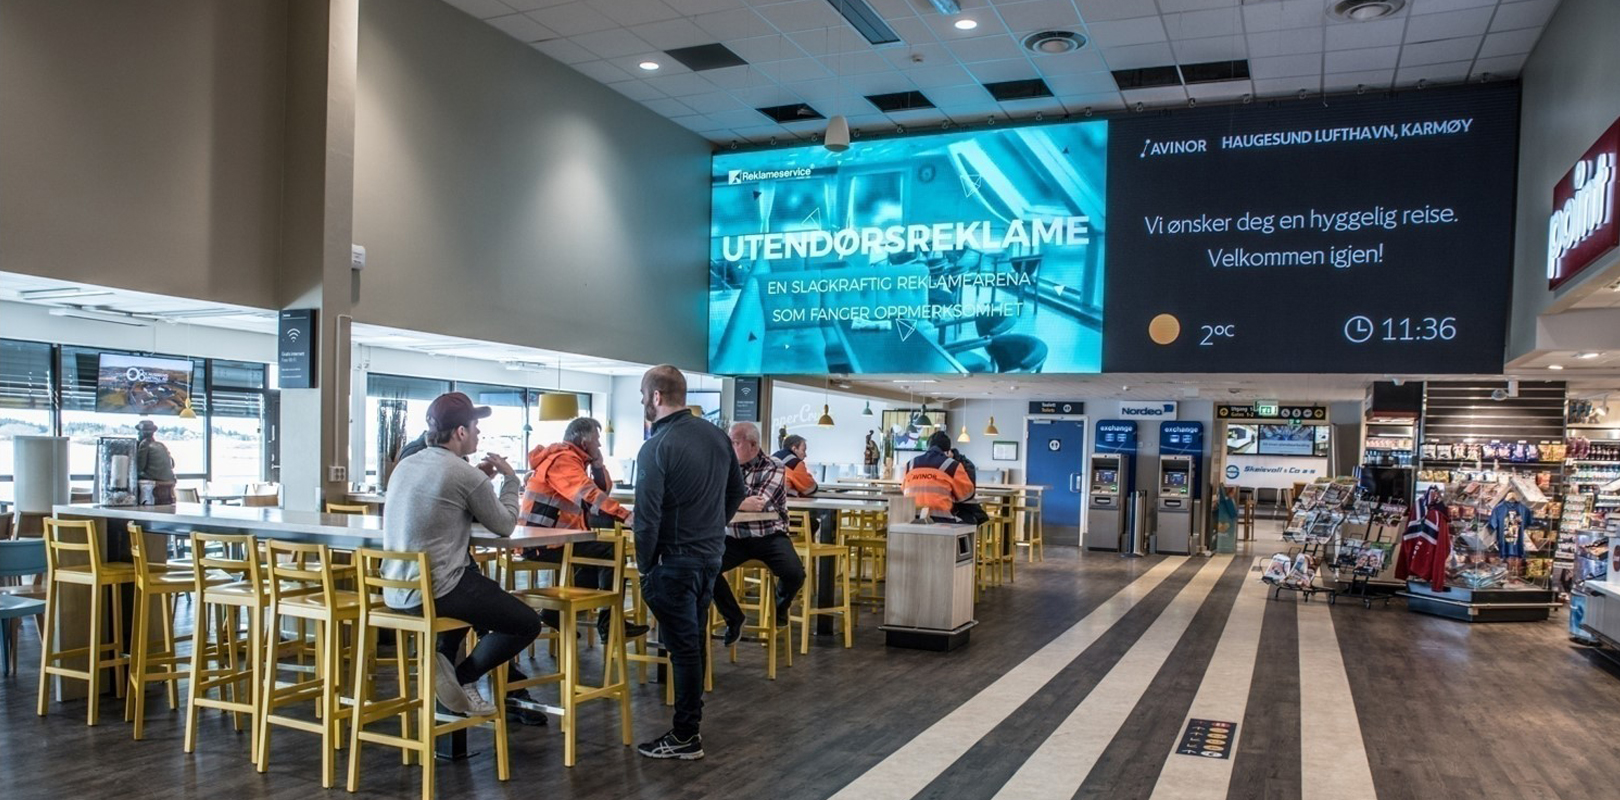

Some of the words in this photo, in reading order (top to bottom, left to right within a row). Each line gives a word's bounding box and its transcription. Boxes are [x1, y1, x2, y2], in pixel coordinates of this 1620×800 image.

[1150, 138, 1207, 156] AVINOR
[1221, 131, 1312, 150] HAUGESUND
[1314, 124, 1399, 144] LUFTHAVN,
[1401, 117, 1473, 138] KARMØY
[742, 167, 811, 181] Reklameservice
[1144, 215, 1164, 235] Vi
[1167, 212, 1232, 234] ønsker
[1236, 210, 1275, 235] deg
[1278, 212, 1305, 229] en
[1310, 205, 1398, 233] hyggelig
[1402, 204, 1459, 225] reise.
[1547, 153, 1614, 279] point
[721, 214, 1091, 262] UTENDØRSREKLAME
[1208, 247, 1325, 268] Velkommen
[1329, 243, 1384, 269] igjen!
[767, 280, 787, 295] EN
[791, 274, 893, 295] SLAGKRAFTIG
[896, 271, 1031, 292] REKLAMEARENA
[772, 306, 806, 323] SOM
[809, 306, 870, 322] FANGER
[873, 301, 1024, 321] OPPMERKSOMHET
[1382, 316, 1457, 342] 11:36
[1121, 407, 1163, 416] Nordea
[1164, 426, 1199, 434] exchange
[912, 473, 938, 481] AVINOR
